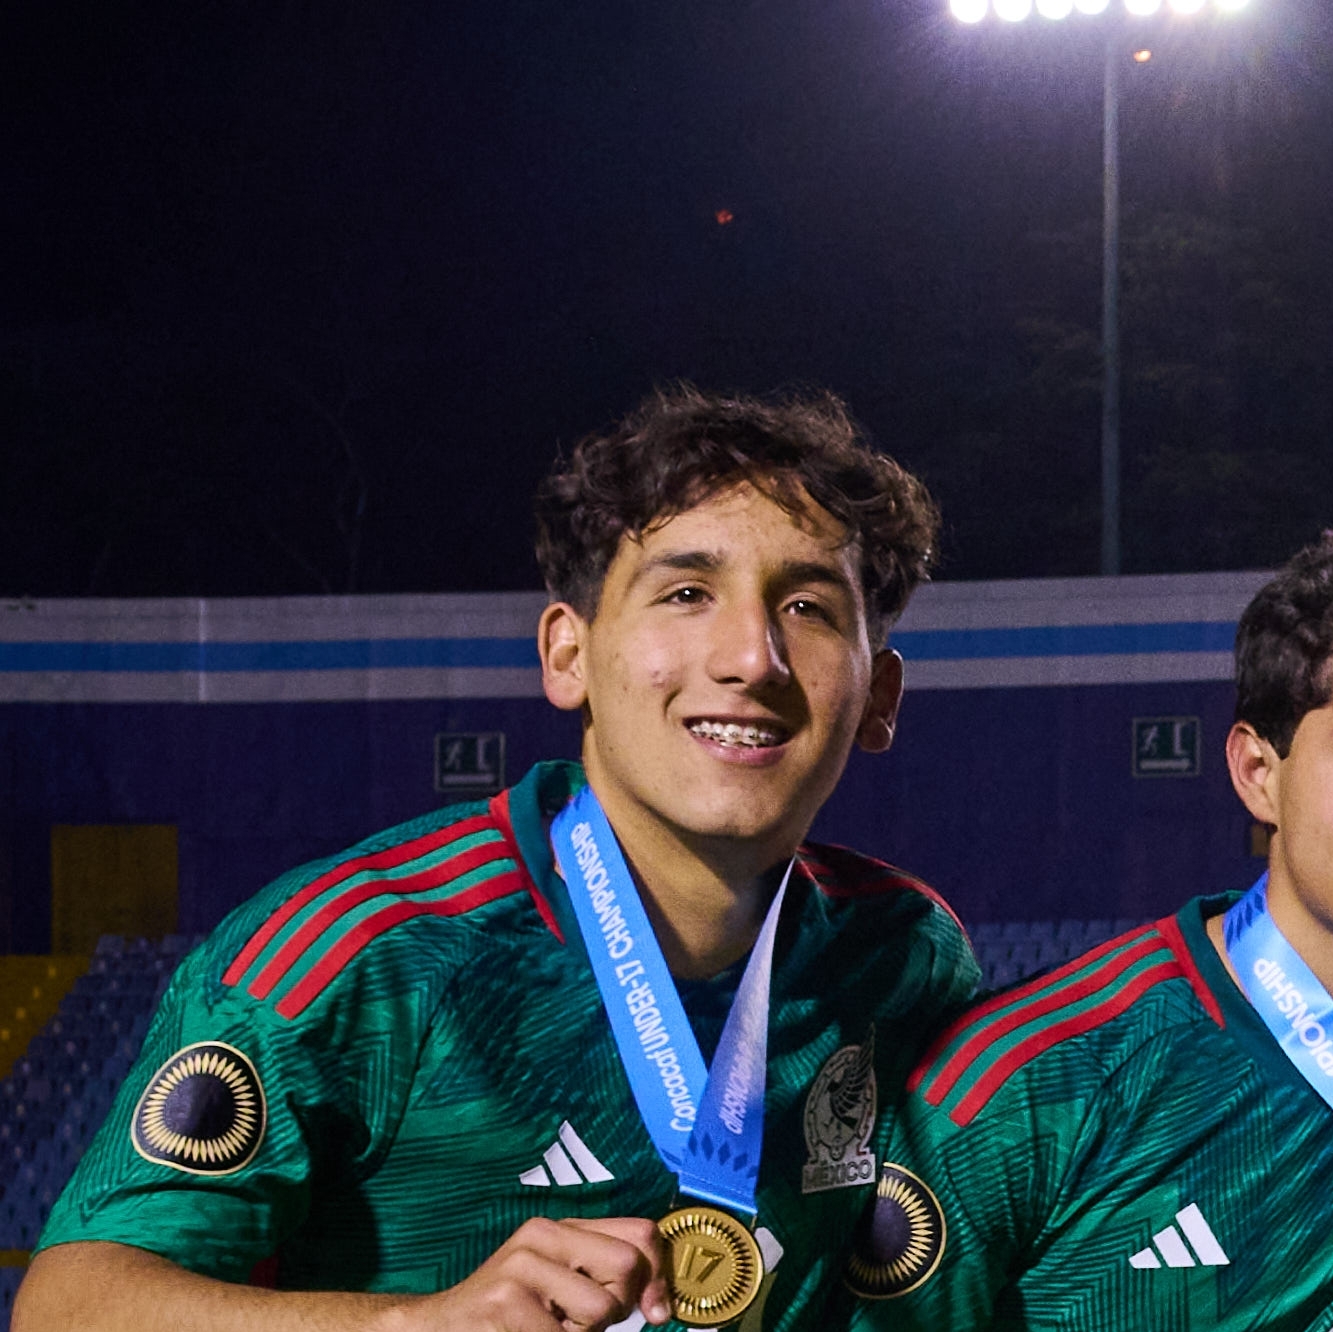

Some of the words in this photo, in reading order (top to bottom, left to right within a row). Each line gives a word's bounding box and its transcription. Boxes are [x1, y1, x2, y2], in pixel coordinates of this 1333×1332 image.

[570, 821, 635, 960] CHAMPIONSHIP
[615, 958, 671, 1052] UNDER-17
[645, 1047, 697, 1133] Concacaf
[677, 1243, 726, 1284] 17
